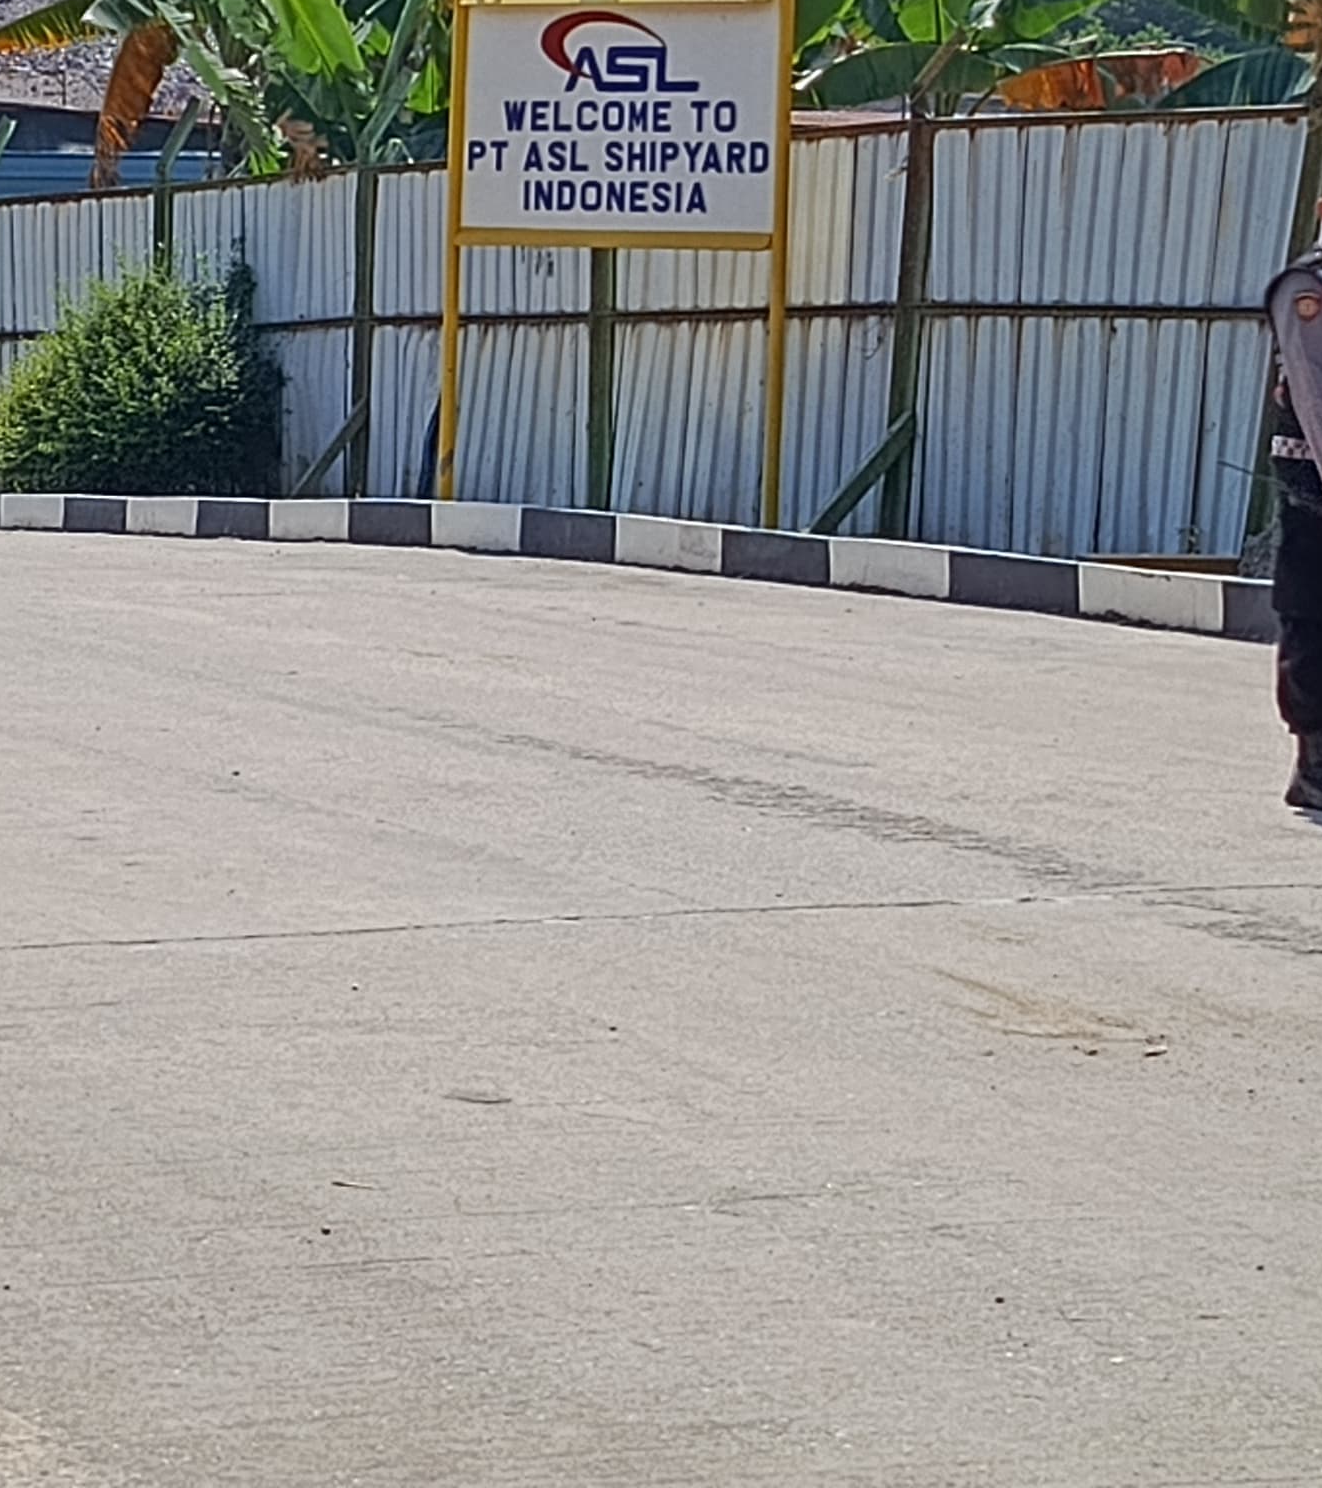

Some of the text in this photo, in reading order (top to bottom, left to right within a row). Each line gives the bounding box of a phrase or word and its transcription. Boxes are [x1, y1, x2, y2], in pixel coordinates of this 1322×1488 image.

[564, 46, 700, 92] ASL
[504, 100, 738, 133] WELCOME TO
[467, 139, 770, 174] PT ASL SHIPYARD
[523, 180, 707, 213] INDONESIA
